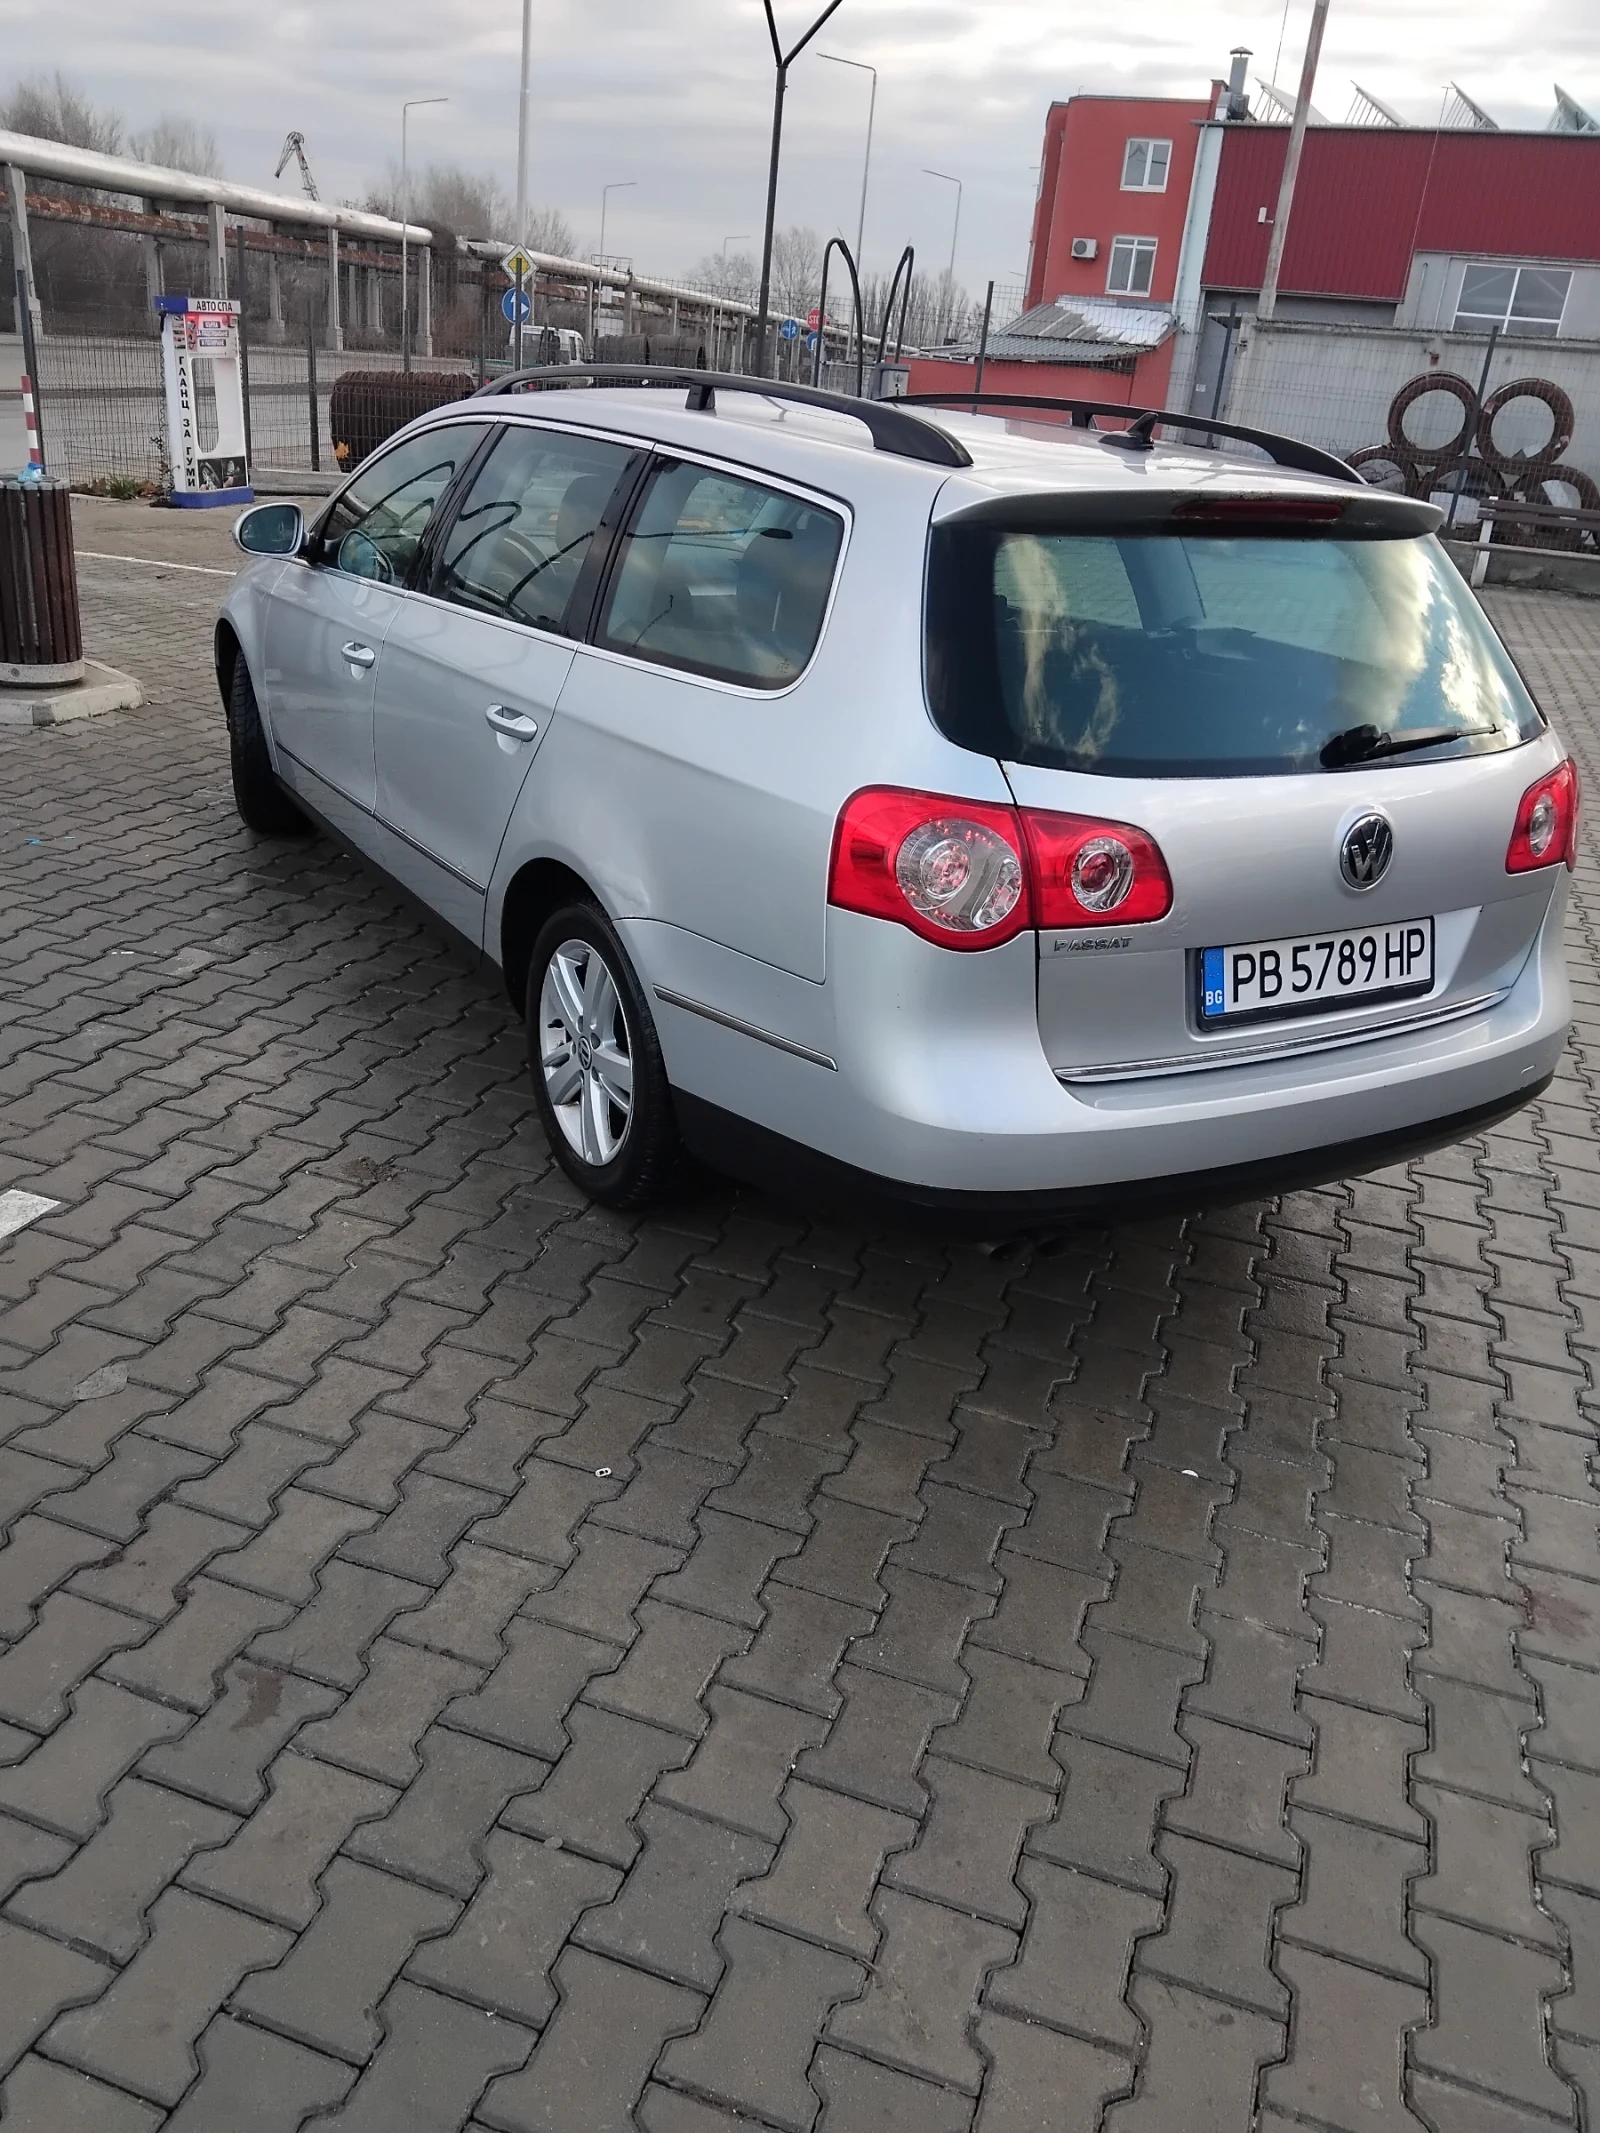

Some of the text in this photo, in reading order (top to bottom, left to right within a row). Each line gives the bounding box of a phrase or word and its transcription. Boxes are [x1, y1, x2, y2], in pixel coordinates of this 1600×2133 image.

[196, 300, 233, 313] АВТО СПА
[179, 356, 196, 487] ГЛАНЦ ЗА ГУМИ
[1053, 936, 1133, 952] PASSAT
[1291, 936, 1377, 993] 5789
[1205, 990, 1223, 1006] BG
